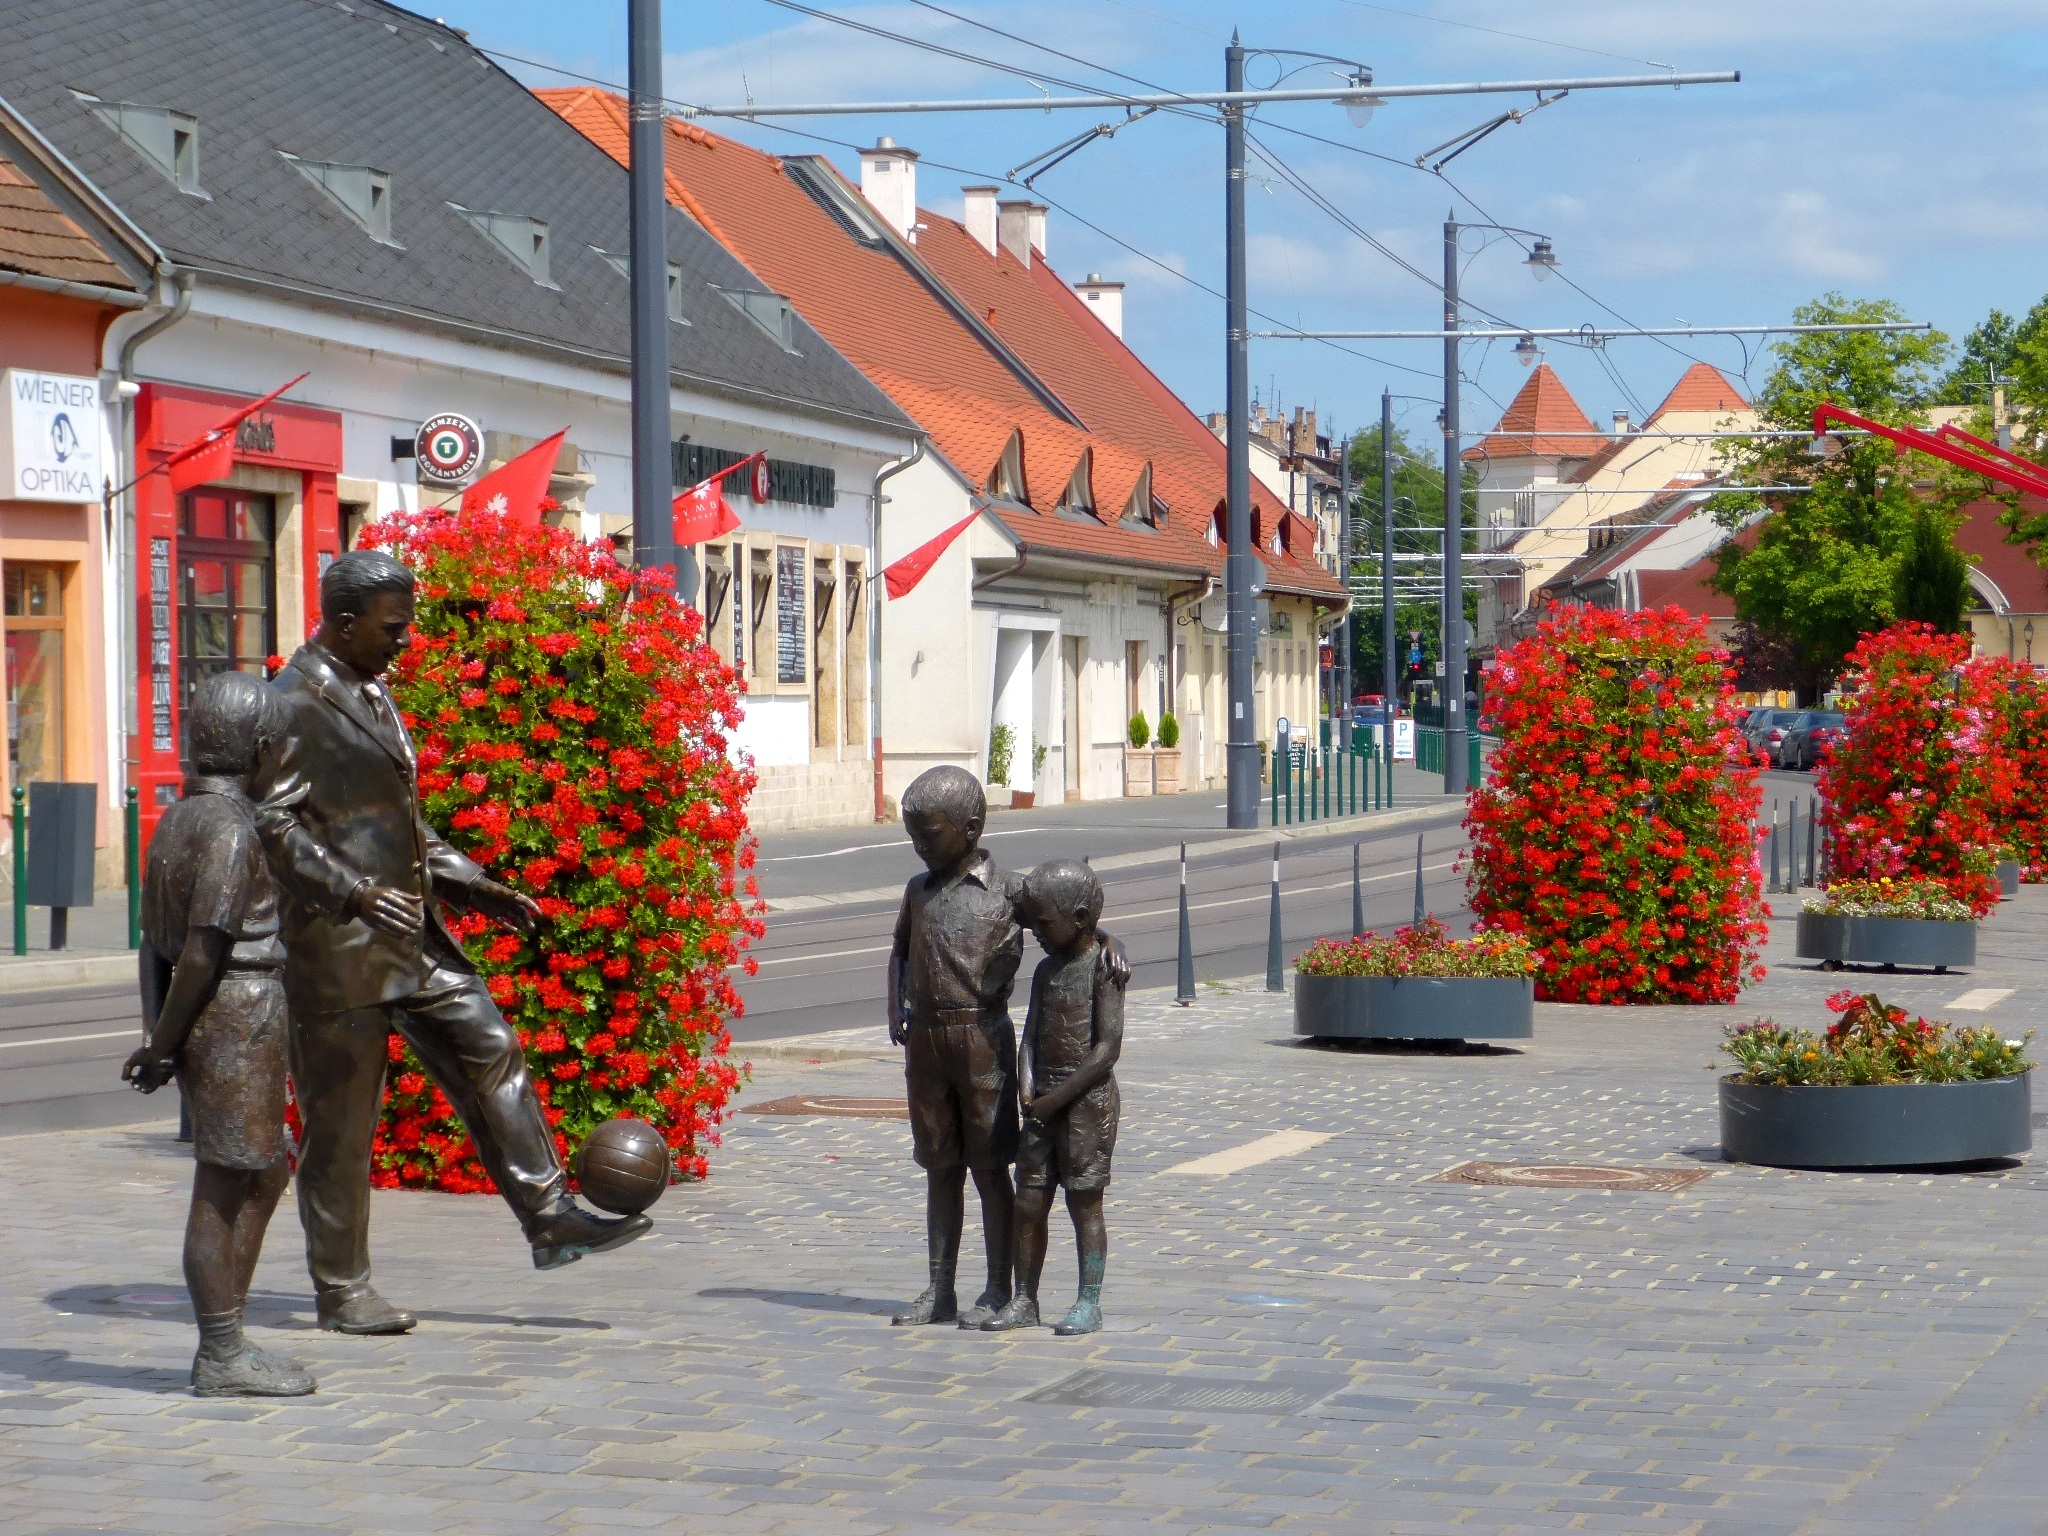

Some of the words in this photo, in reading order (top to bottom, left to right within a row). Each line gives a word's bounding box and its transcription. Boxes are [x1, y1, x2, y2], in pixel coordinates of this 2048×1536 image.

[15, 377, 95, 408] WIENER
[425, 417, 469, 433] NEMZETI
[440, 441, 454, 454] T
[420, 453, 477, 478] DOHÁNYBOLT
[21, 467, 95, 495] OPTIKA
[812, 465, 835, 509] PUB
[672, 501, 717, 522] SYMB
[1399, 722, 1408, 737] P
